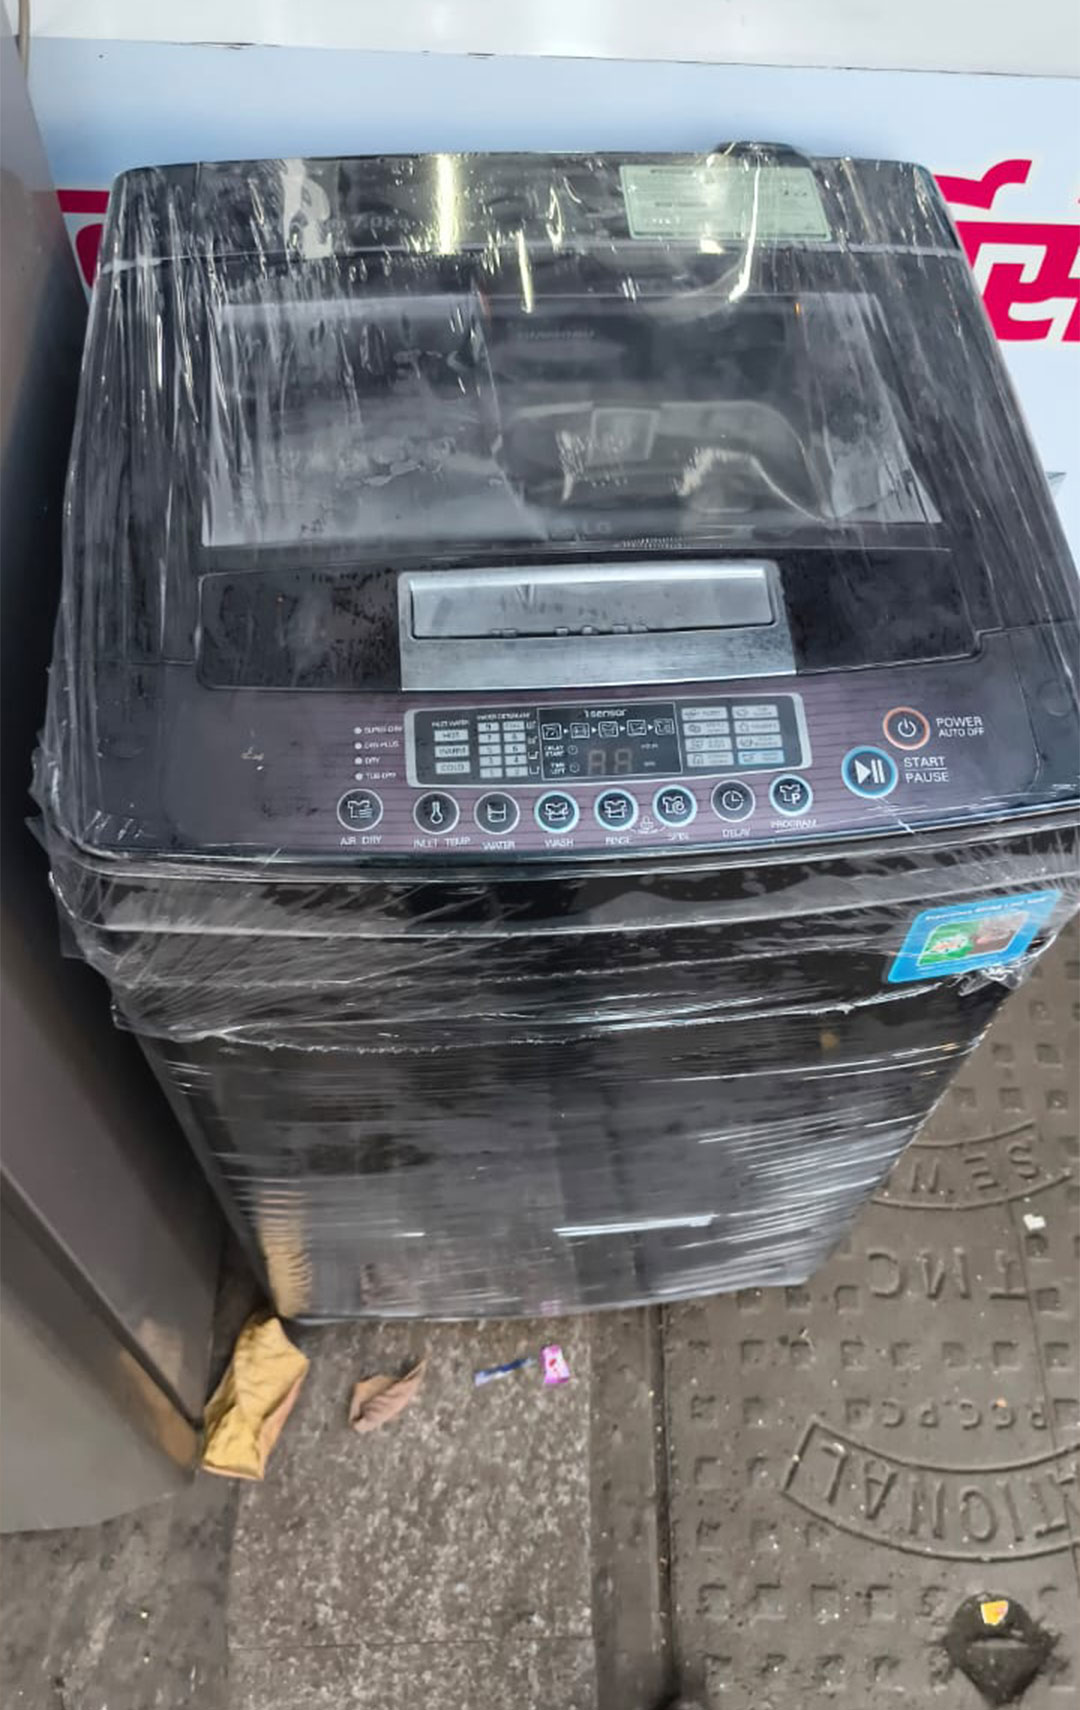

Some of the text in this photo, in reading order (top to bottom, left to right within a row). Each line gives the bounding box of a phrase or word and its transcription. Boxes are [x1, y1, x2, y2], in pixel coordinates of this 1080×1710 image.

[935, 716, 983, 728] POWER
[939, 727, 985, 737] AUTO OFF
[904, 756, 946, 768] START
[905, 772, 949, 783] PAUSE
[722, 828, 751, 838] DELAY
[341, 835, 383, 846] AIR DRY
[481, 840, 516, 850] WATER
[545, 838, 575, 848] WASH
